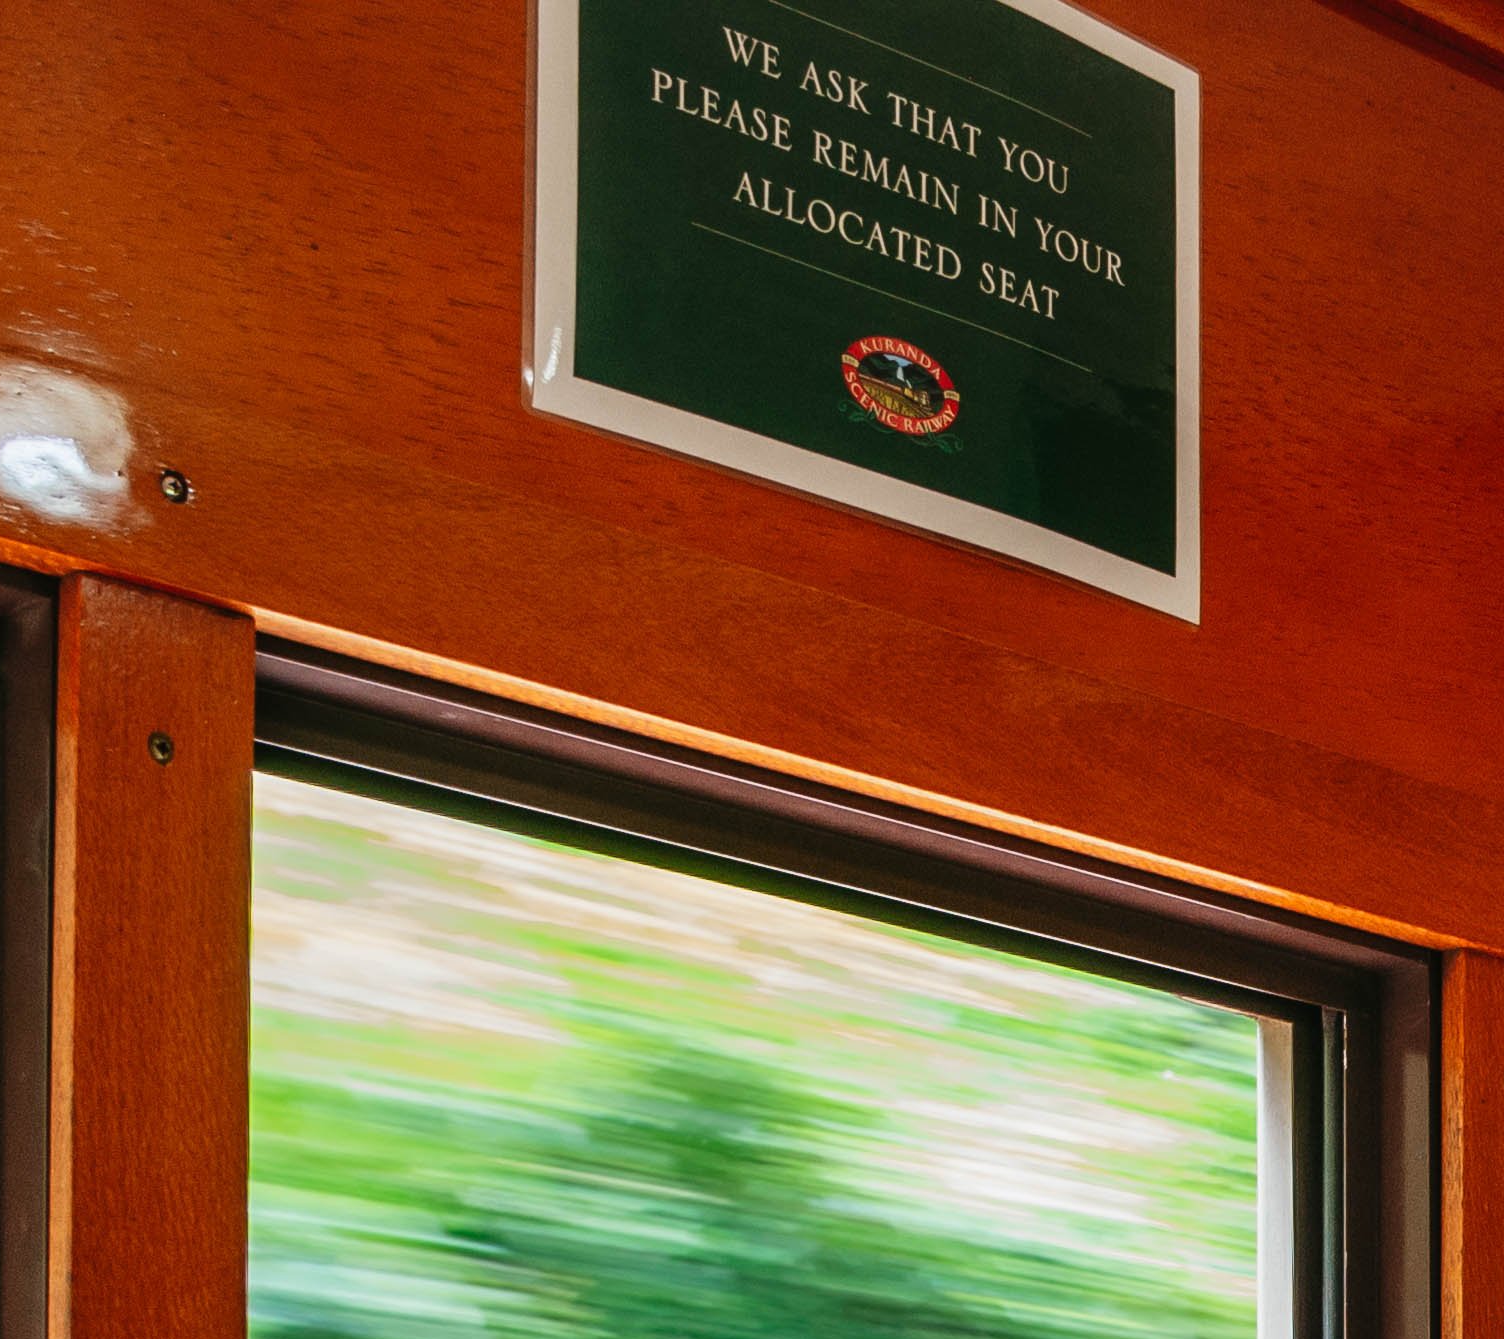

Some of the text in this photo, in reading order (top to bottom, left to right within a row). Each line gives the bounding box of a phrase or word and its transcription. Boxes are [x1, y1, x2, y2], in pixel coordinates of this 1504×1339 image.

[651, 67, 1126, 287] PLEASE REMAIN IN YOUR
[722, 26, 1070, 194] WE ASK THAT YOU
[732, 171, 1060, 321] ALLOCATED SEAT
[845, 371, 956, 433] SCENIC RAILWAY
[860, 338, 941, 380] KURANDA
